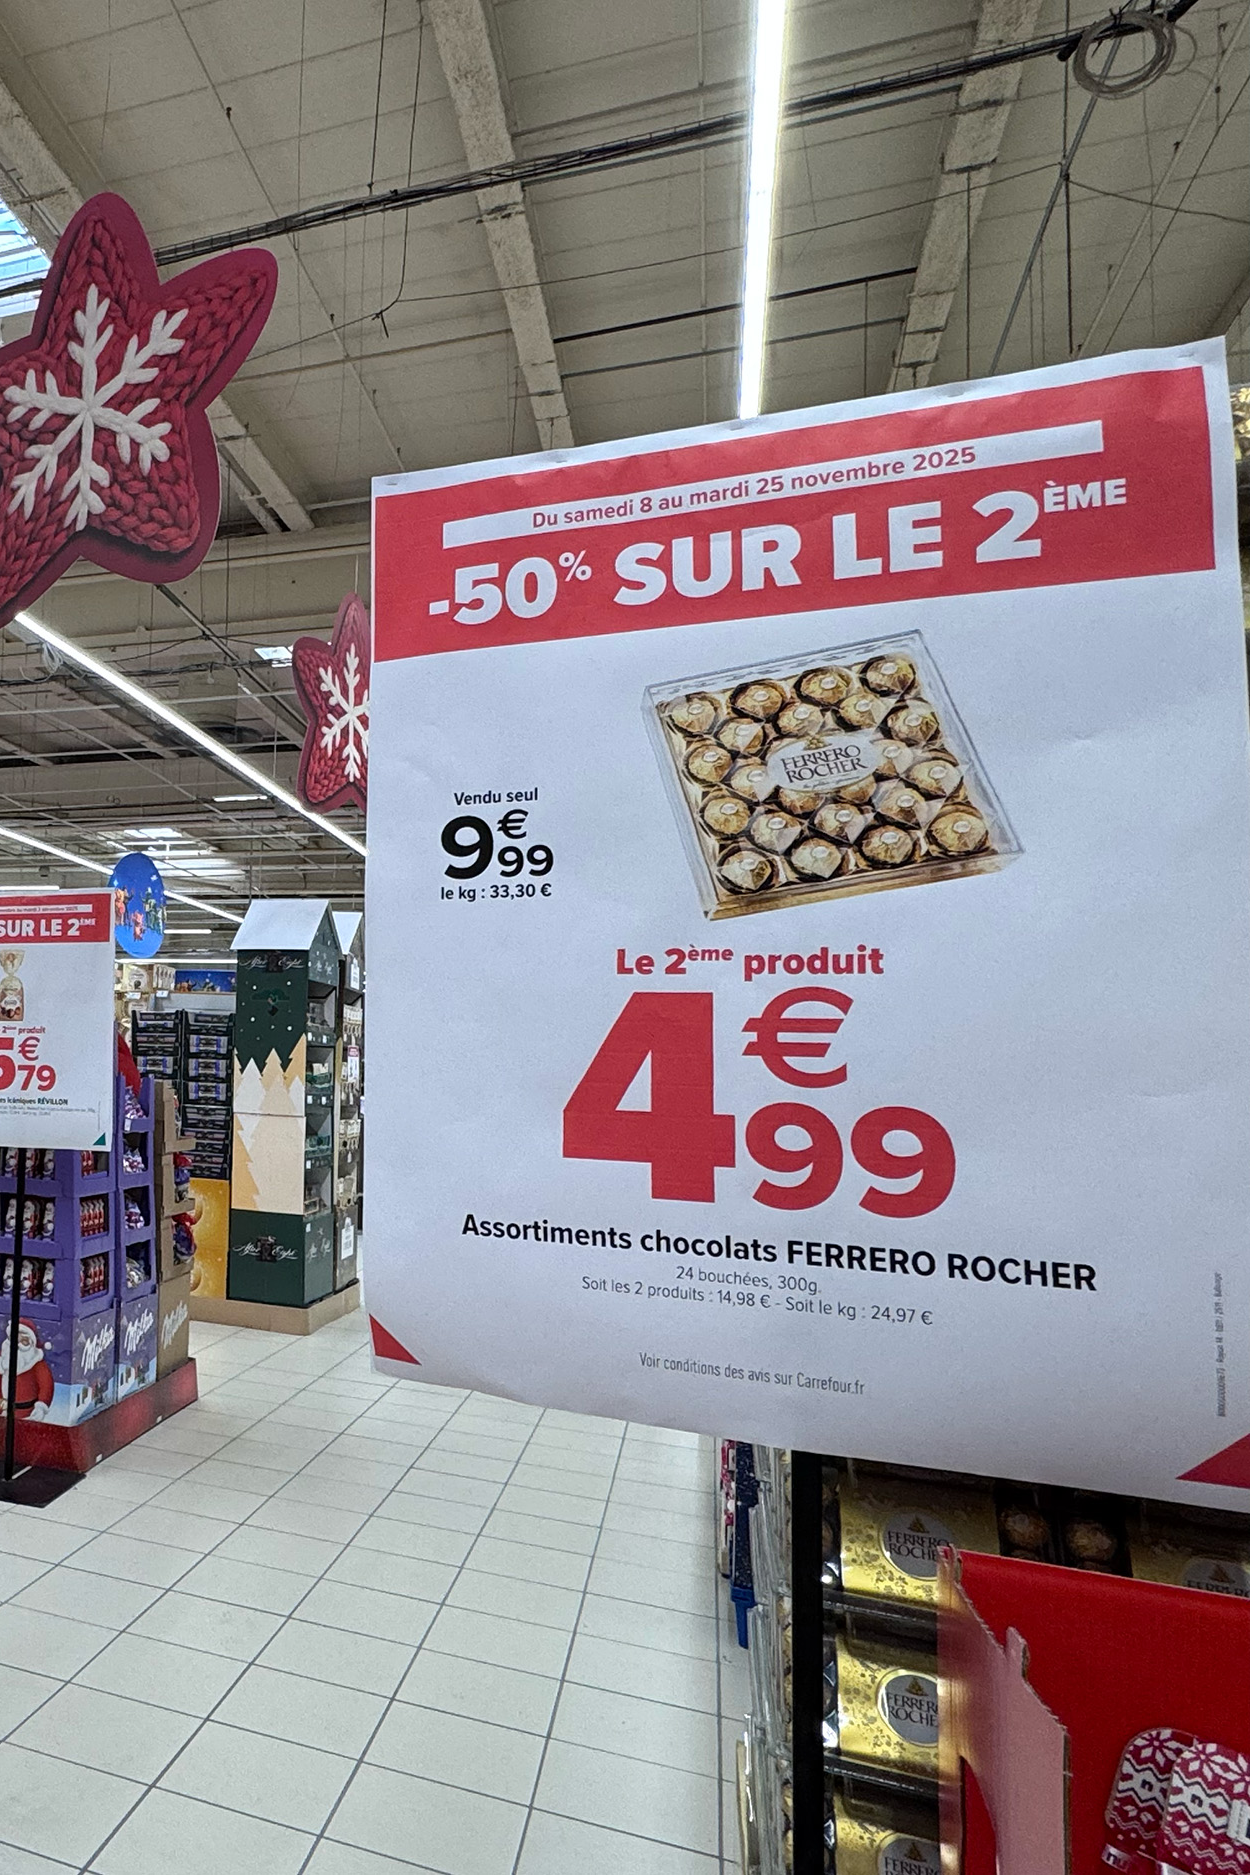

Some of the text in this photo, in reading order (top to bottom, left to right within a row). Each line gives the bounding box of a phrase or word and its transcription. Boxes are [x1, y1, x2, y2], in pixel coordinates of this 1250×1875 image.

[533, 446, 976, 529] Du samedi 8 au mardi 25 novembre 2025
[428, 550, 592, 625] -50%
[613, 523, 802, 606] SUR
[832, 500, 943, 580] LE
[780, 744, 861, 770] FERRERO
[785, 757, 869, 783] ROCHER
[454, 787, 538, 806] Vendu seul
[441, 886, 454, 900] le
[458, 886, 476, 902] kg
[489, 884, 536, 900] 33,30
[540, 883, 552, 897] €
[40, 918, 63, 937] LE
[616, 944, 884, 982] Le 2ème produit
[461, 1213, 1098, 1292] Assortiments chocolats FERRERO ROCHER
[675, 1266, 694, 1280] 24
[698, 1267, 773, 1291] bouchées,
[582, 1275, 608, 1291] Soit
[611, 1278, 631, 1294] les
[634, 1281, 643, 1295] 2
[648, 1283, 705, 1302] produits
[717, 1291, 755, 1308] 14,98
[760, 1294, 771, 1309] €
[785, 1296, 815, 1314] Soit
[819, 1299, 833, 1315] le
[837, 1301, 857, 1320] kg
[871, 1305, 916, 1324] 24,97
[921, 1311, 934, 1326] €
[124, 1308, 154, 1356] Milka
[81, 1323, 115, 1376] Milka
[639, 1352, 865, 1395] Voir conditions des avis sur Carrefour.fr
[887, 1530, 951, 1548] FERRERO
[888, 1543, 938, 1563] ROCHE
[888, 1706, 938, 1728] ROCHE
